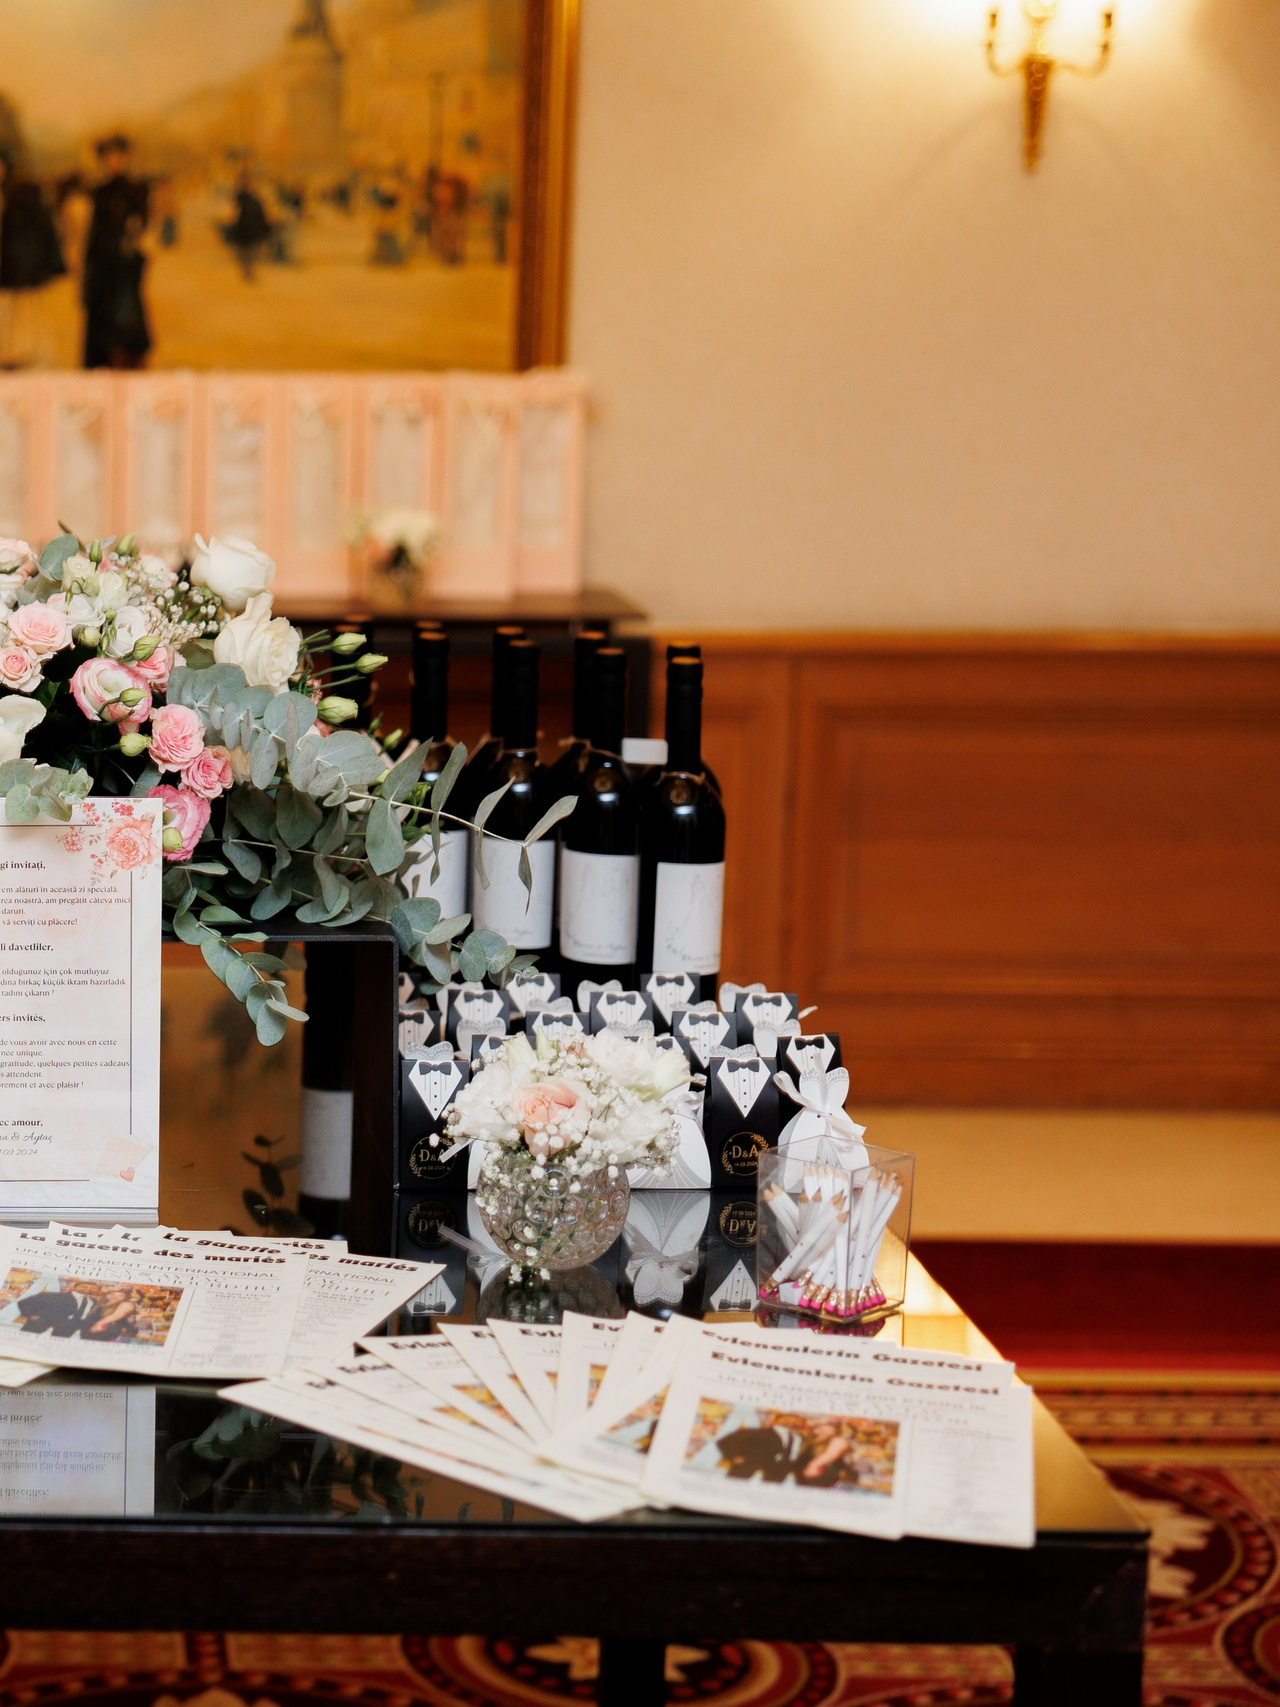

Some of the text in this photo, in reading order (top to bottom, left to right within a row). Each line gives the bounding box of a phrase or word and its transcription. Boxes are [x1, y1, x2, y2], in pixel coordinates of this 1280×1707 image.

[1, 907, 26, 915] daruri.
[8, 942, 54, 952] davetliler,
[43, 968, 58, 976] için
[58, 968, 73, 977] çok
[18, 978, 41, 987] birkaç
[67, 978, 89, 986] ikram
[13, 1013, 46, 1022] invités,
[0, 1059, 36, 1069] gratitude,
[36, 1059, 72, 1069] quelques
[99, 1059, 129, 1067] cadeaux
[56, 1081, 80, 1090] plaisir
[732, 1144, 759, 1159] D&A
[61, 1228, 87, 1238] La
[19, 1232, 287, 1264] La gazette des mariés
[162, 1232, 282, 1255] La gazette
[16, 1247, 38, 1255] UN
[148, 1264, 277, 1279] INTERNATIONAL
[337, 1257, 419, 1272] mariés
[308, 1269, 396, 1284] RNATIONAL
[872, 1352, 983, 1373] Gazetesi
[711, 1351, 1000, 1396] Evlenenlerin Gazetesi
